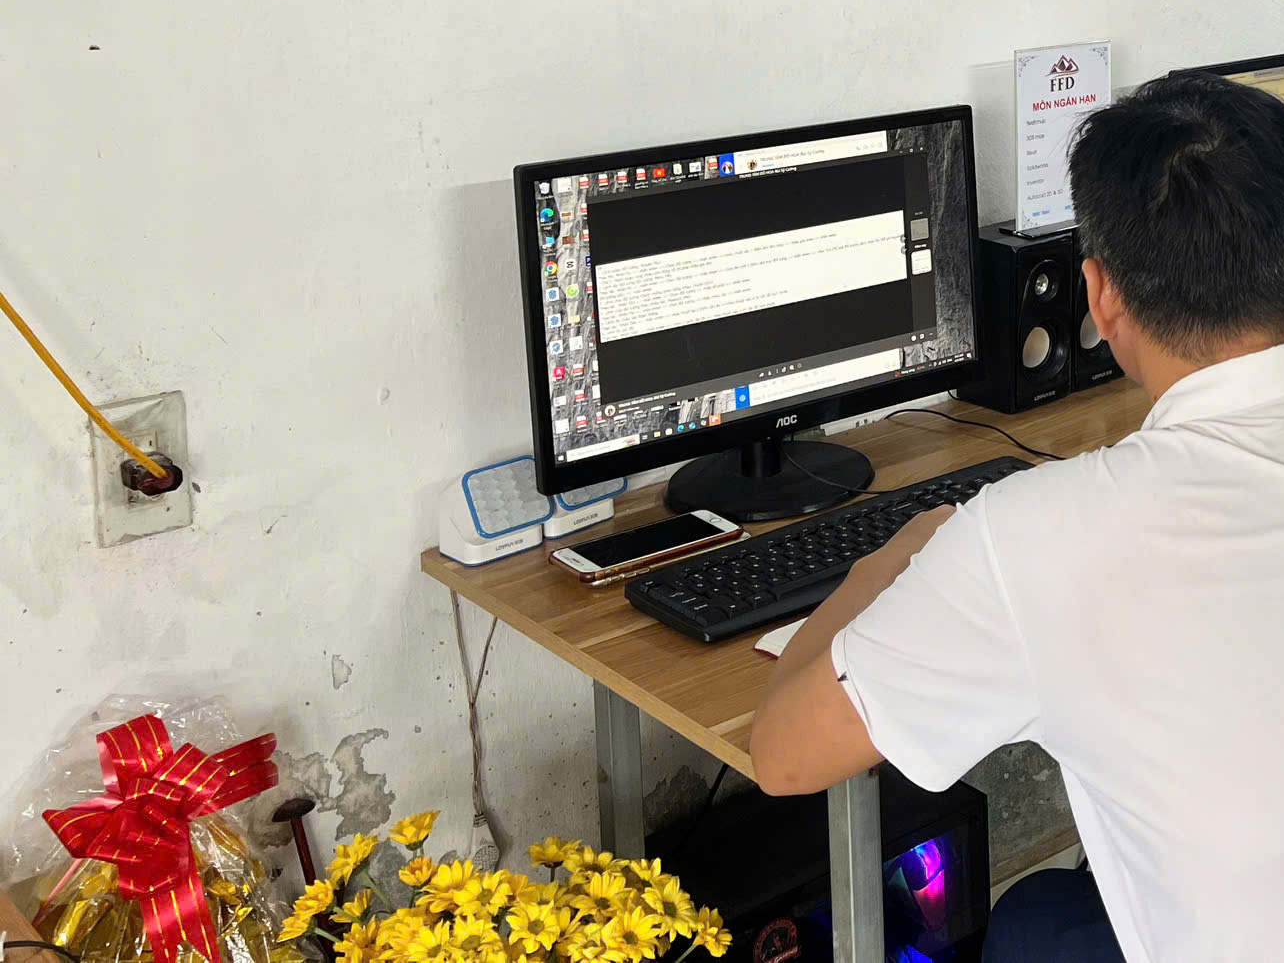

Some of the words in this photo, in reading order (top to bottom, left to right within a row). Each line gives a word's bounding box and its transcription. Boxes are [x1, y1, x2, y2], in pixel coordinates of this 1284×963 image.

[1050, 76, 1075, 93] FFD
[1032, 99, 1052, 112] MÔN
[1079, 93, 1097, 106] HẠN
[776, 414, 797, 428] AOC
